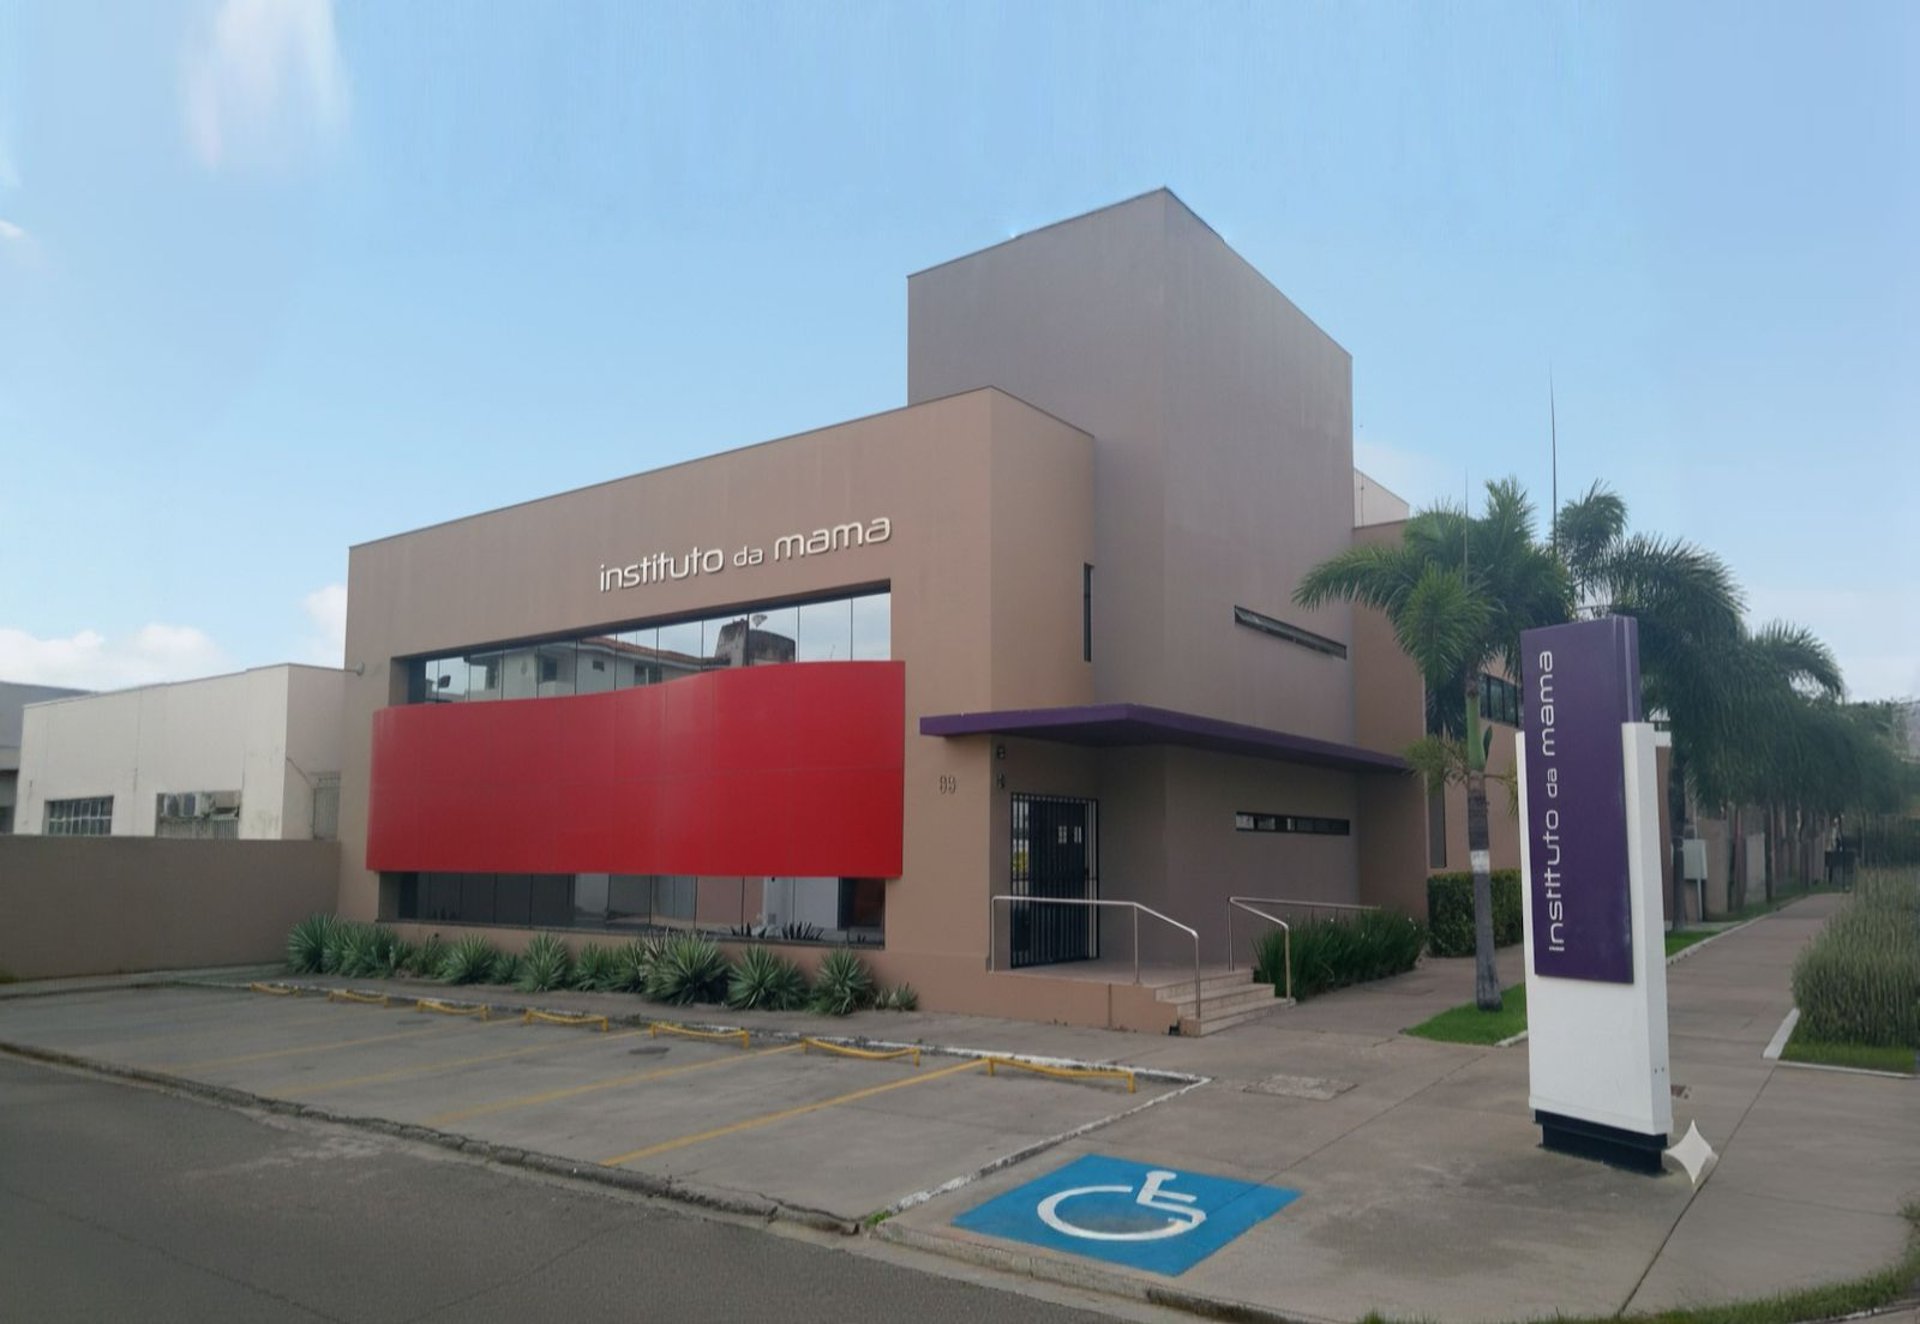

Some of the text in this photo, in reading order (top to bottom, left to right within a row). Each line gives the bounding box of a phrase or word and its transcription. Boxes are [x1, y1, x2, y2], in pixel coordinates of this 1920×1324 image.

[599, 516, 892, 593] instituto da mama
[1539, 650, 1565, 952] instituto da mama
